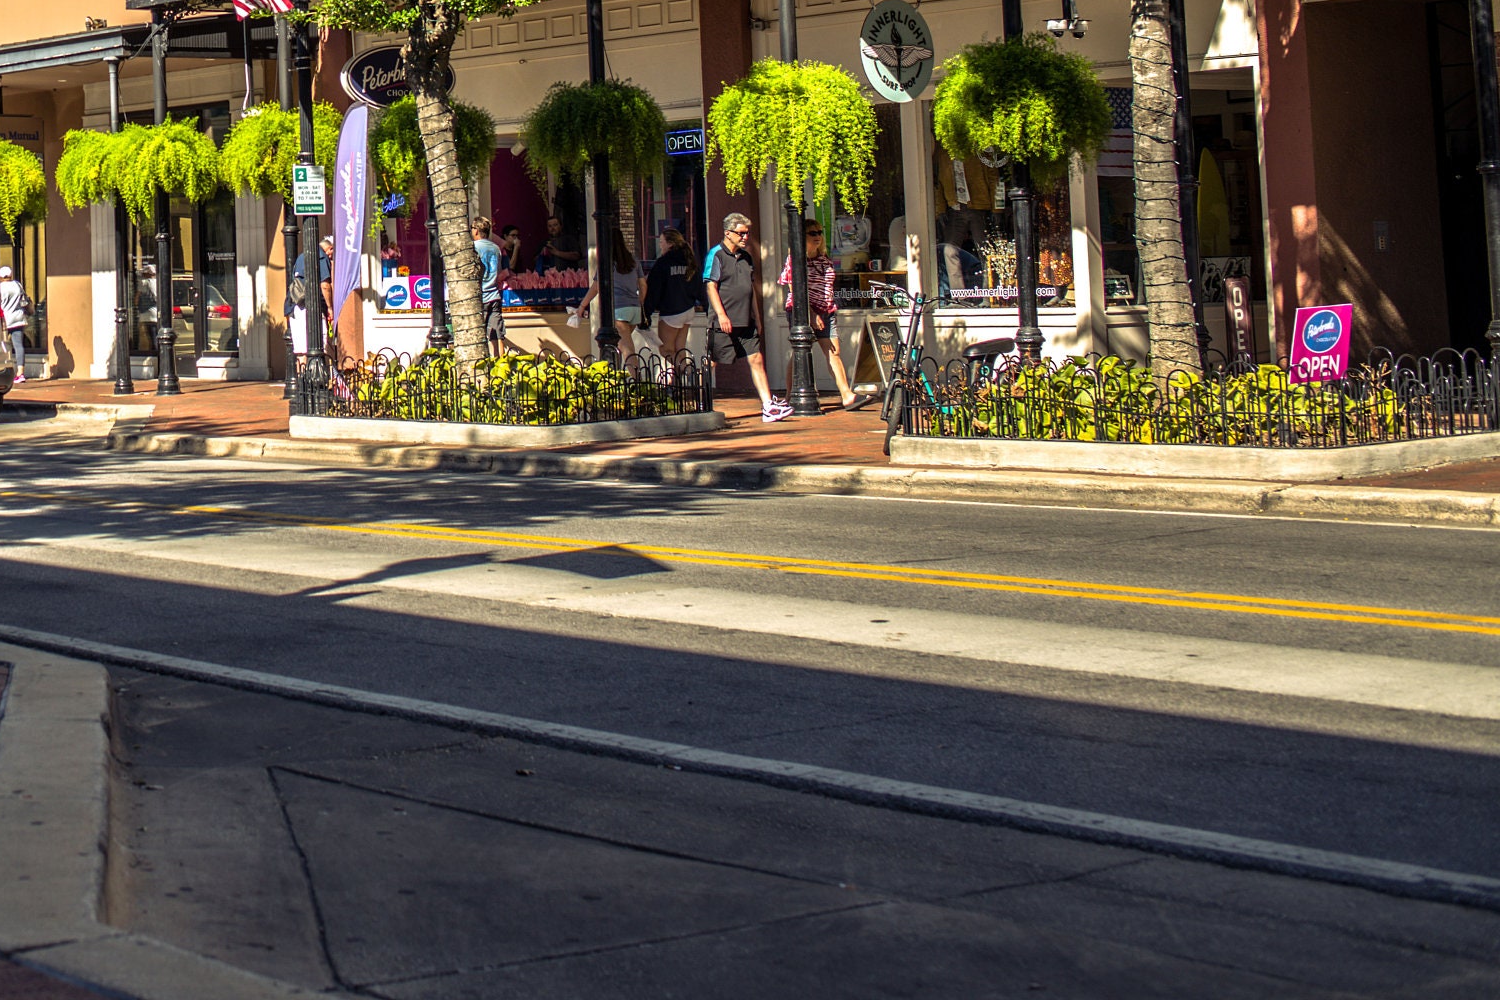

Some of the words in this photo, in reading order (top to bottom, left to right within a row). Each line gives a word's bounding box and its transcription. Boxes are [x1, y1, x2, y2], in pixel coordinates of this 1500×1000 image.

[868, 10, 927, 47] INNERLIGHT
[362, 58, 405, 94] Peterb
[881, 75, 898, 92] SURF
[899, 77, 917, 92] SHOP
[9, 130, 39, 140] Mutual
[667, 134, 702, 150] OPEN
[298, 170, 304, 180] 2
[670, 265, 688, 276] NAV
[1297, 354, 1340, 379] OPEN
